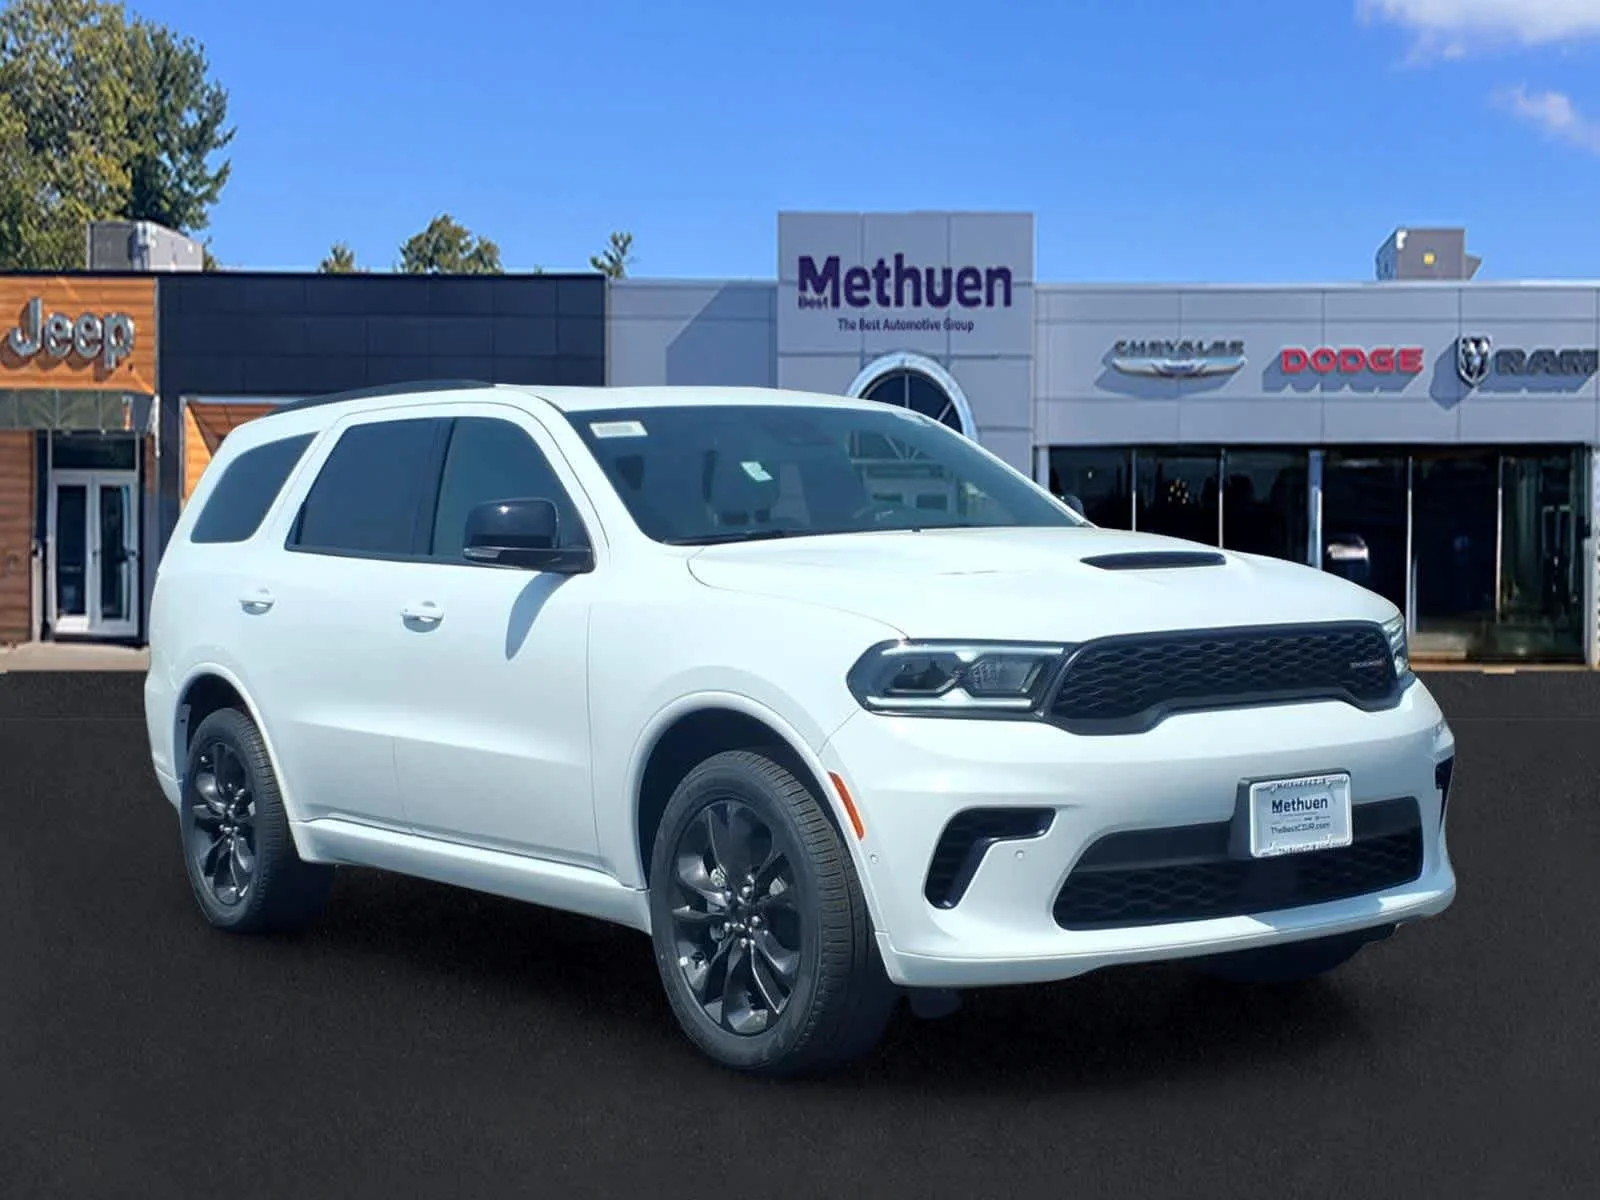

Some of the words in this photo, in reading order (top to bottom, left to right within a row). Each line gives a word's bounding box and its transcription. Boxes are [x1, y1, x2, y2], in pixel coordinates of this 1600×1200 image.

[798, 253, 1012, 308] Methuen
[8, 296, 136, 369] Jeep
[838, 318, 857, 331] The
[859, 318, 881, 331] Best
[883, 318, 941, 331] Automotive
[943, 318, 975, 333] Group
[1281, 348, 1424, 374] DODGE
[1495, 349, 1599, 375] RAM
[1271, 797, 1329, 814] Methuen
